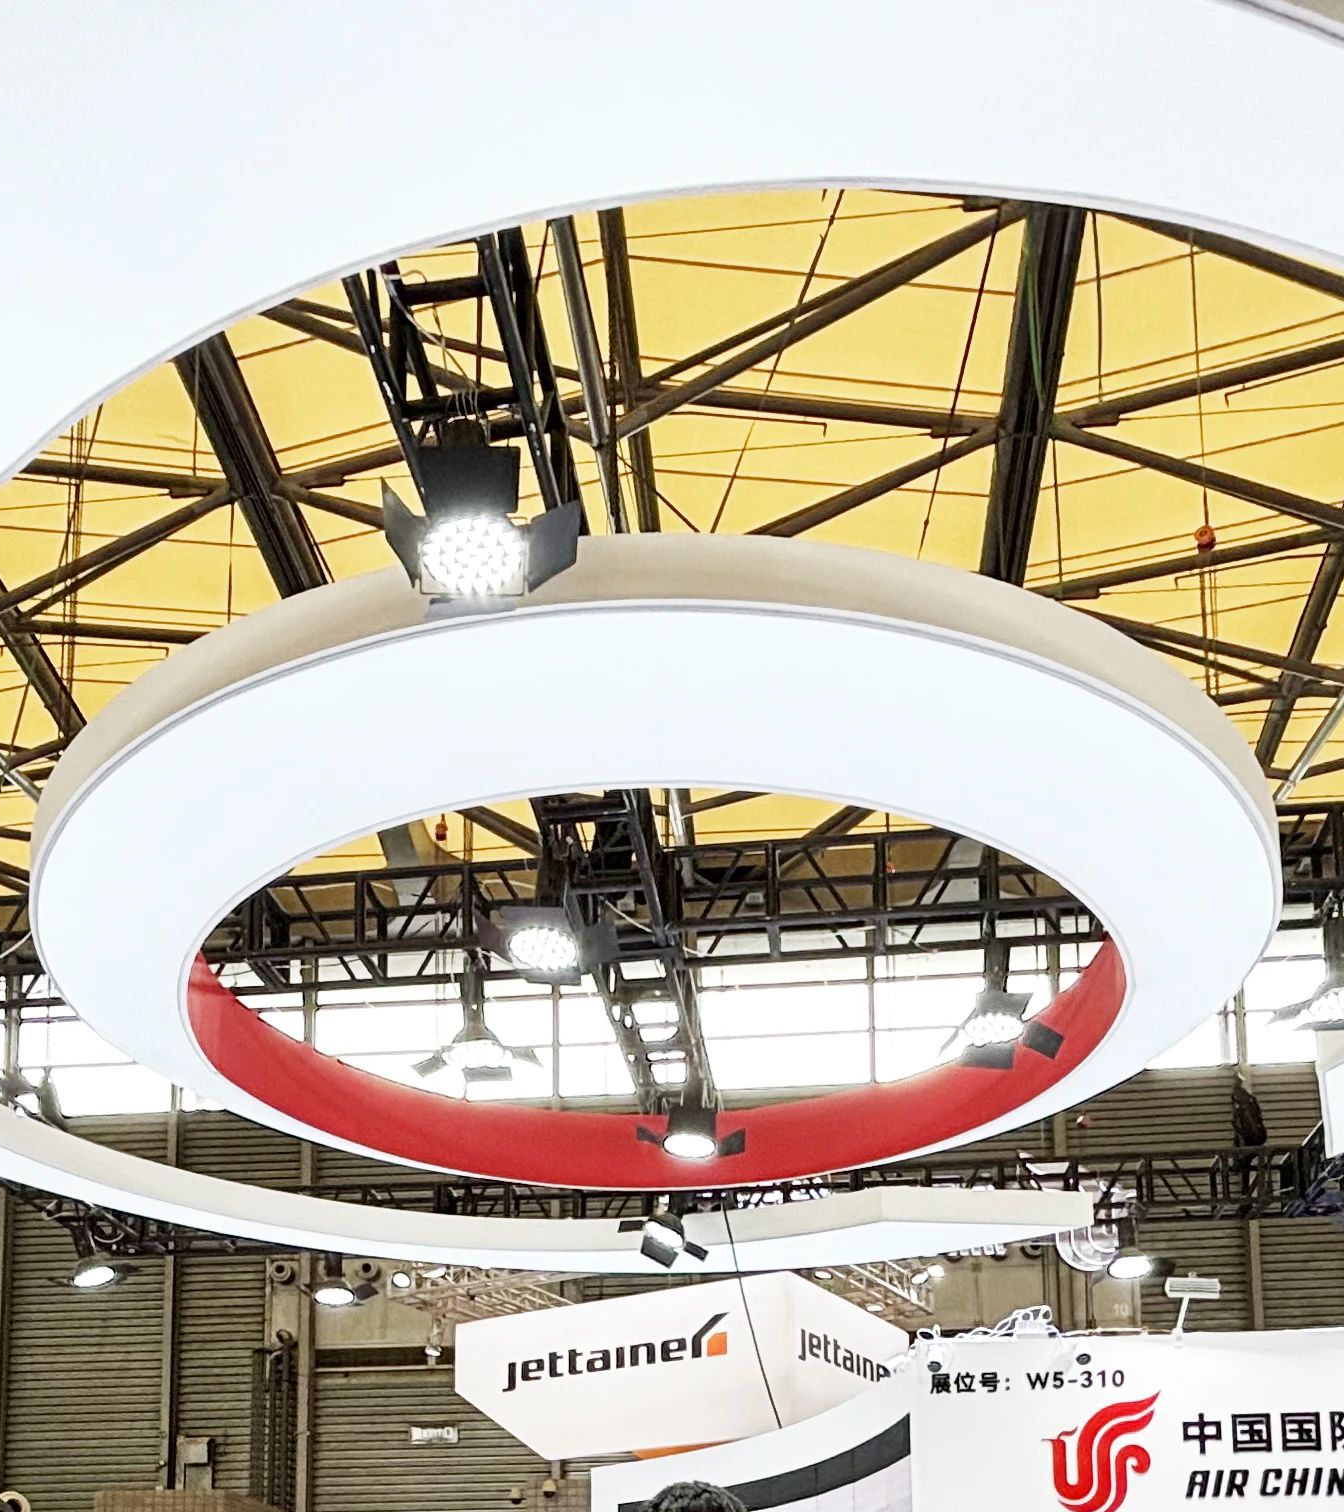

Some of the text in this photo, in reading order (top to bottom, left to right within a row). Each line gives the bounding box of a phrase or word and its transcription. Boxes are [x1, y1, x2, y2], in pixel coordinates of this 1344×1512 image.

[502, 1312, 730, 1392] jettainer
[1026, 1369, 1125, 1391] W5-310
[1185, 1469, 1250, 1499] AIR
